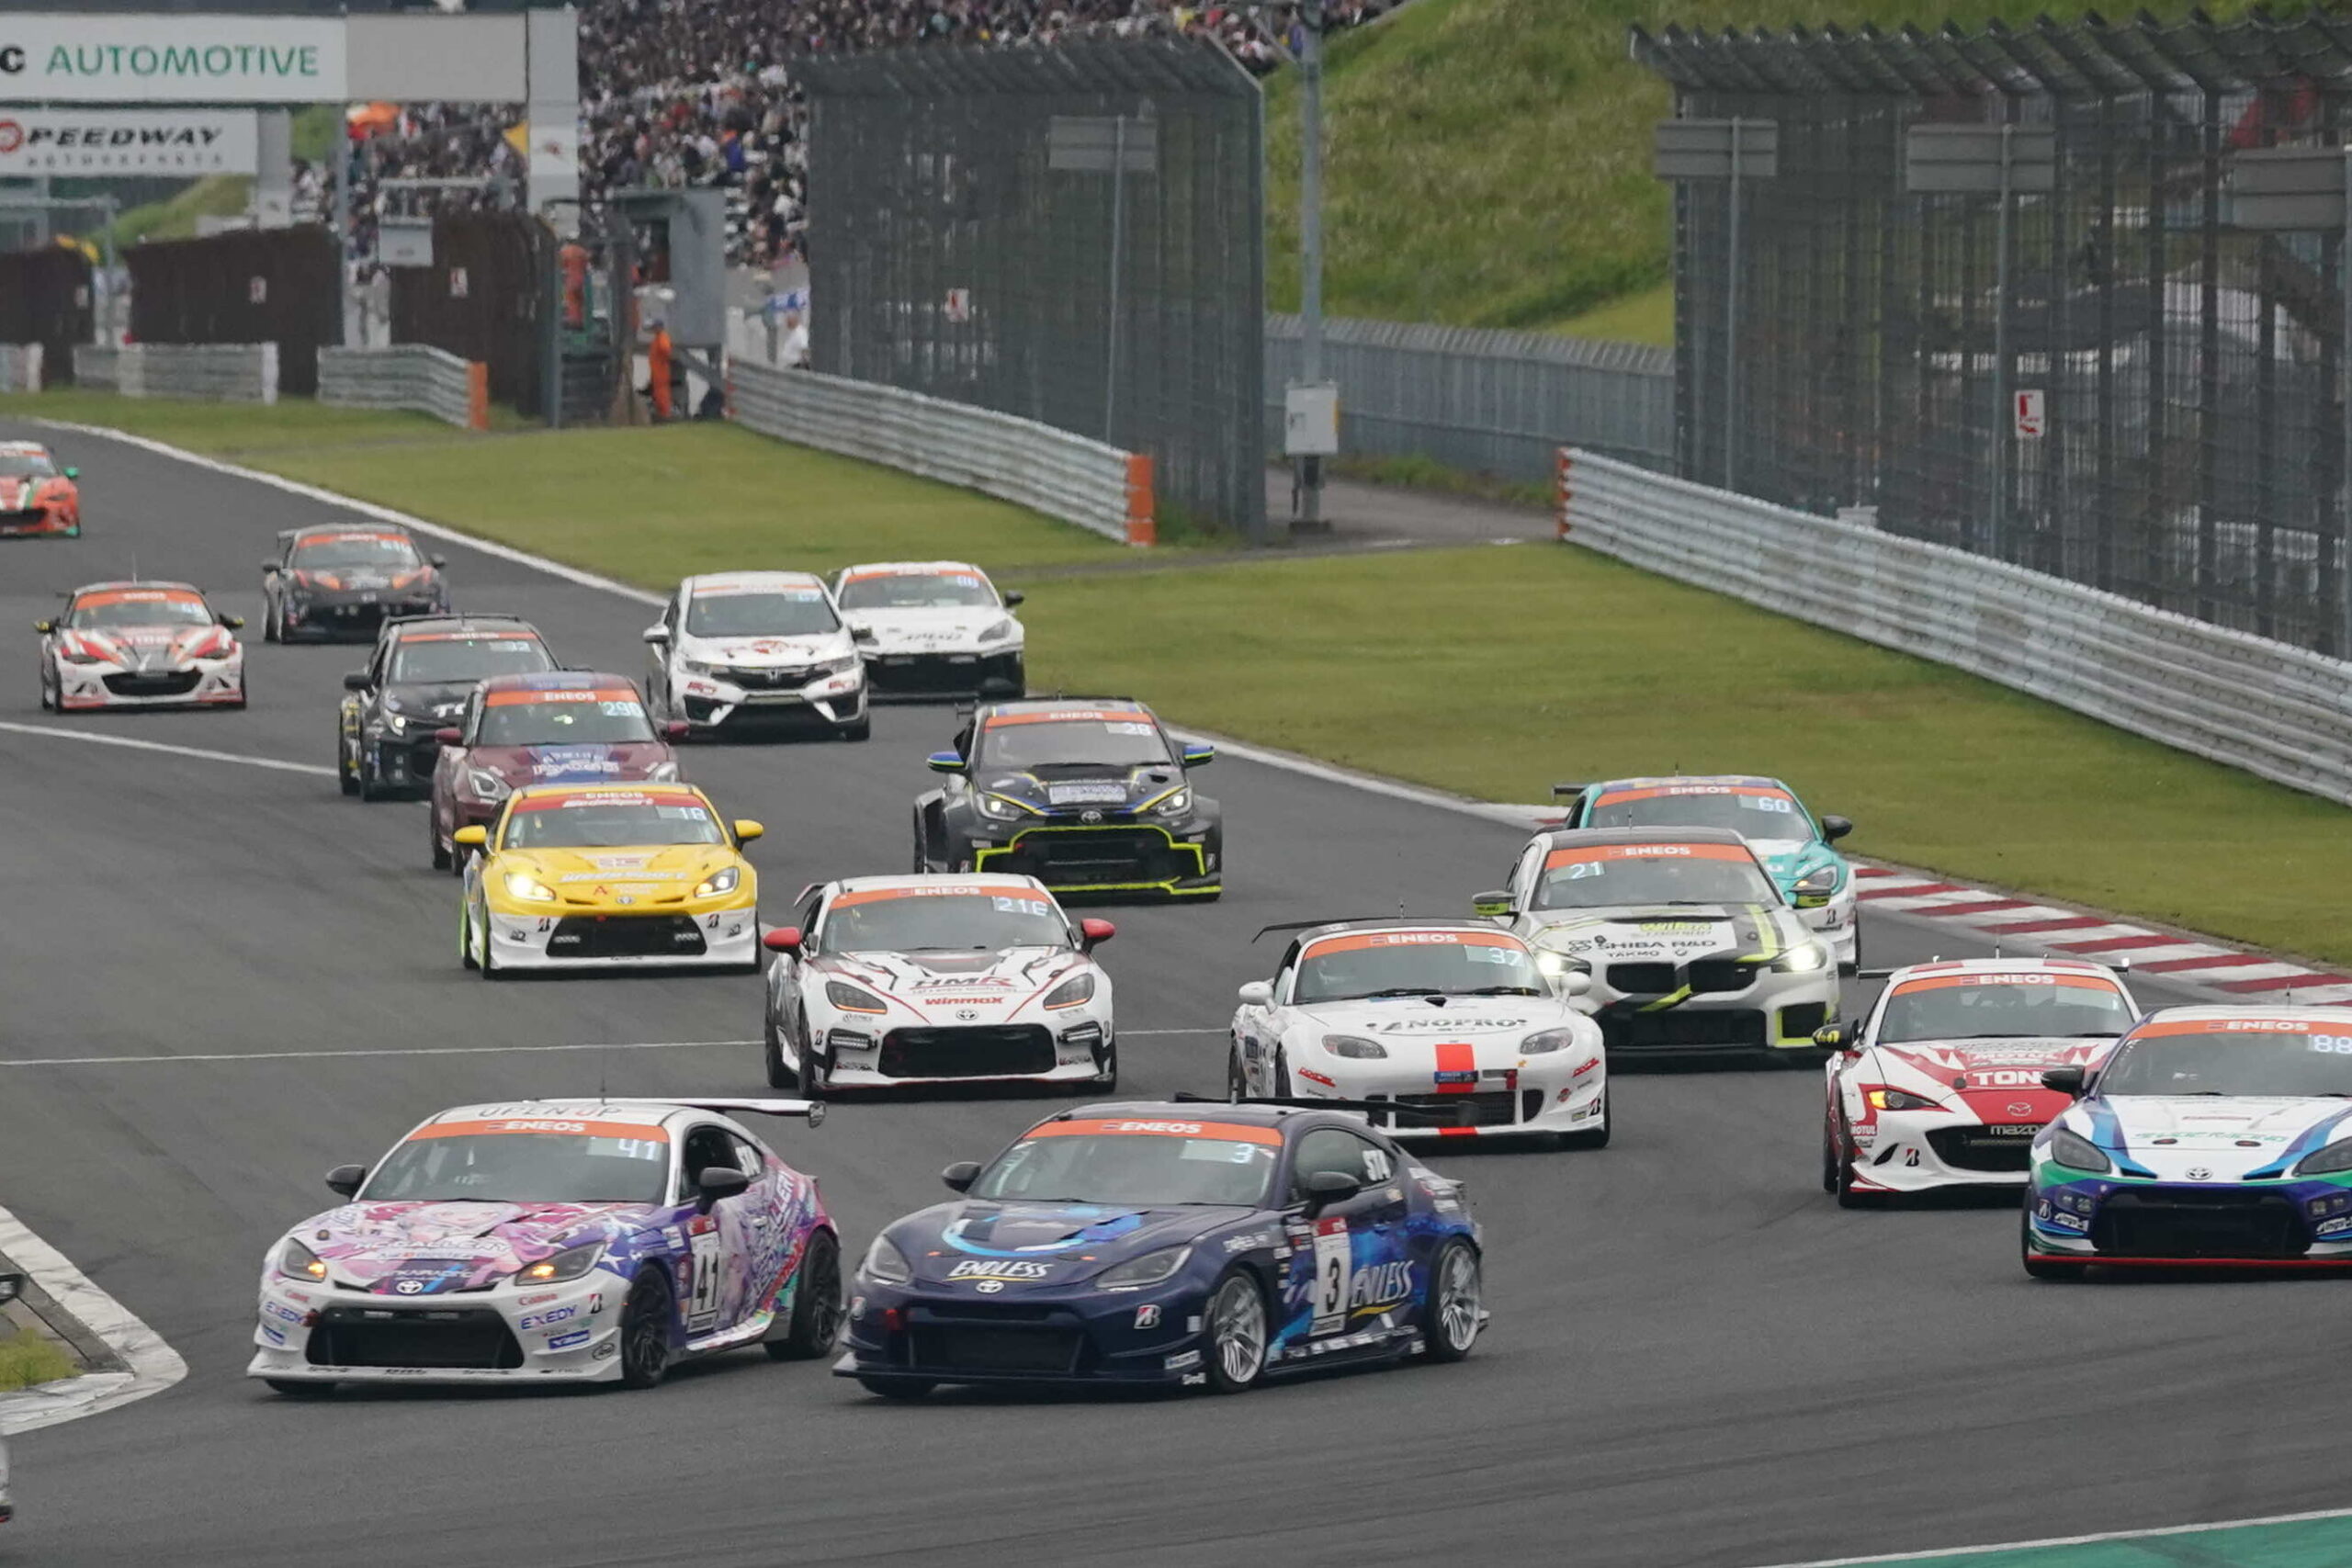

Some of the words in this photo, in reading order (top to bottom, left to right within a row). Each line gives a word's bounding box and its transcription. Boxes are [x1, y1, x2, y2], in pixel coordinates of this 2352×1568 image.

[46, 45, 320, 77] AUTOMOTIVE
[544, 692, 595, 701] ENEOS
[1669, 785, 1730, 795] ENEOS
[1758, 796, 1792, 814] 60
[1625, 845, 1690, 855] ENEOS
[1571, 863, 1602, 879] 21
[914, 886, 980, 897] ENEOS
[1387, 933, 1458, 943] ENEOS
[1488, 947, 1523, 965] 37
[1979, 974, 2055, 986] ENEOS
[2227, 1021, 2310, 1032] ENEOS
[1973, 1069, 2045, 1087] TON
[504, 1121, 586, 1133] ENEOS
[1119, 1122, 1202, 1134] ENEOS
[1990, 1124, 2045, 1136] mazd
[616, 1137, 658, 1161] 41
[1231, 1143, 1256, 1165] 3
[949, 1259, 1056, 1279] ENDLESS
[696, 1252, 718, 1312] 41
[1325, 1257, 1341, 1314] 3
[520, 1304, 579, 1330] EXEDY
